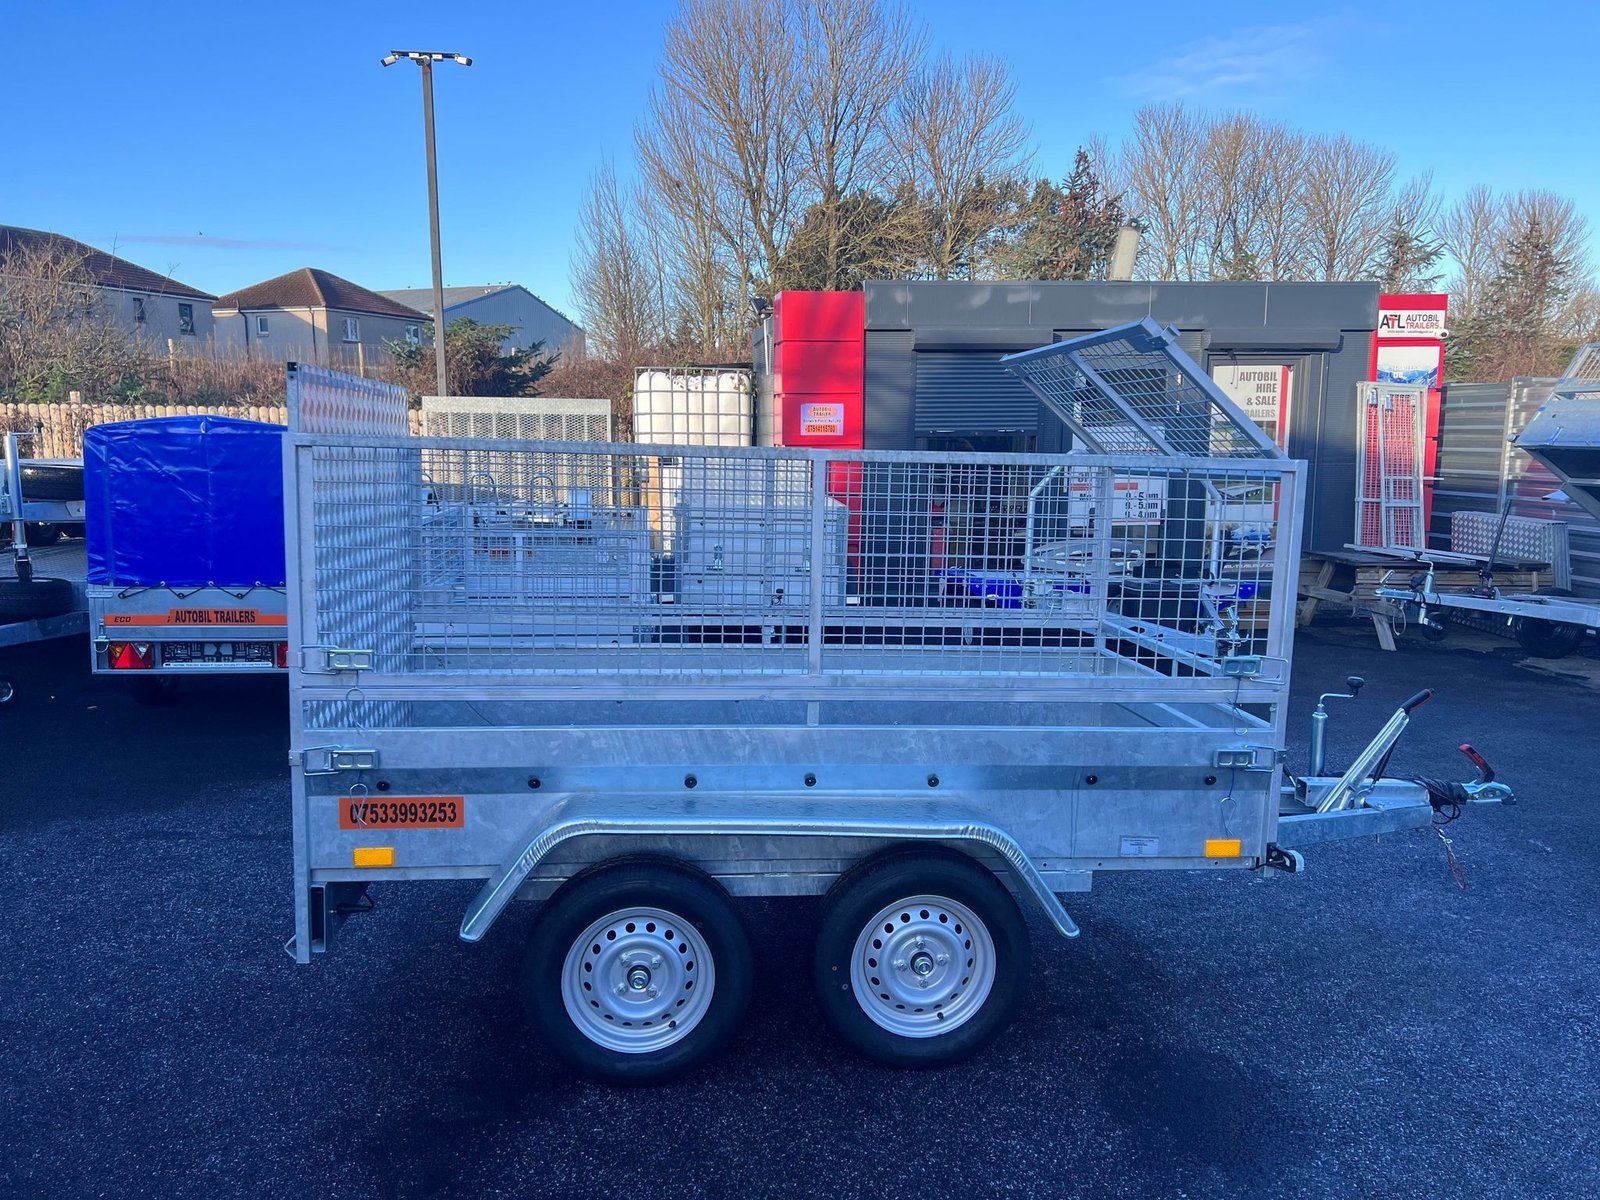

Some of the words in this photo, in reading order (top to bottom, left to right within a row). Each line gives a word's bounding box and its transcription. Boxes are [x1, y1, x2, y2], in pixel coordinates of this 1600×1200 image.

[1380, 314, 1405, 329] ATL
[1406, 314, 1440, 322] AUTOBIL
[1239, 371, 1278, 382] AUTOBIL
[1256, 383, 1278, 393] HIRE
[1246, 397, 1253, 406] &
[1255, 396, 1277, 406] SALE
[1244, 409, 1276, 418] RAILERS
[175, 611, 212, 623] AUTOBIL
[214, 610, 256, 623] TRAILERS
[349, 802, 457, 824] 07533993253
